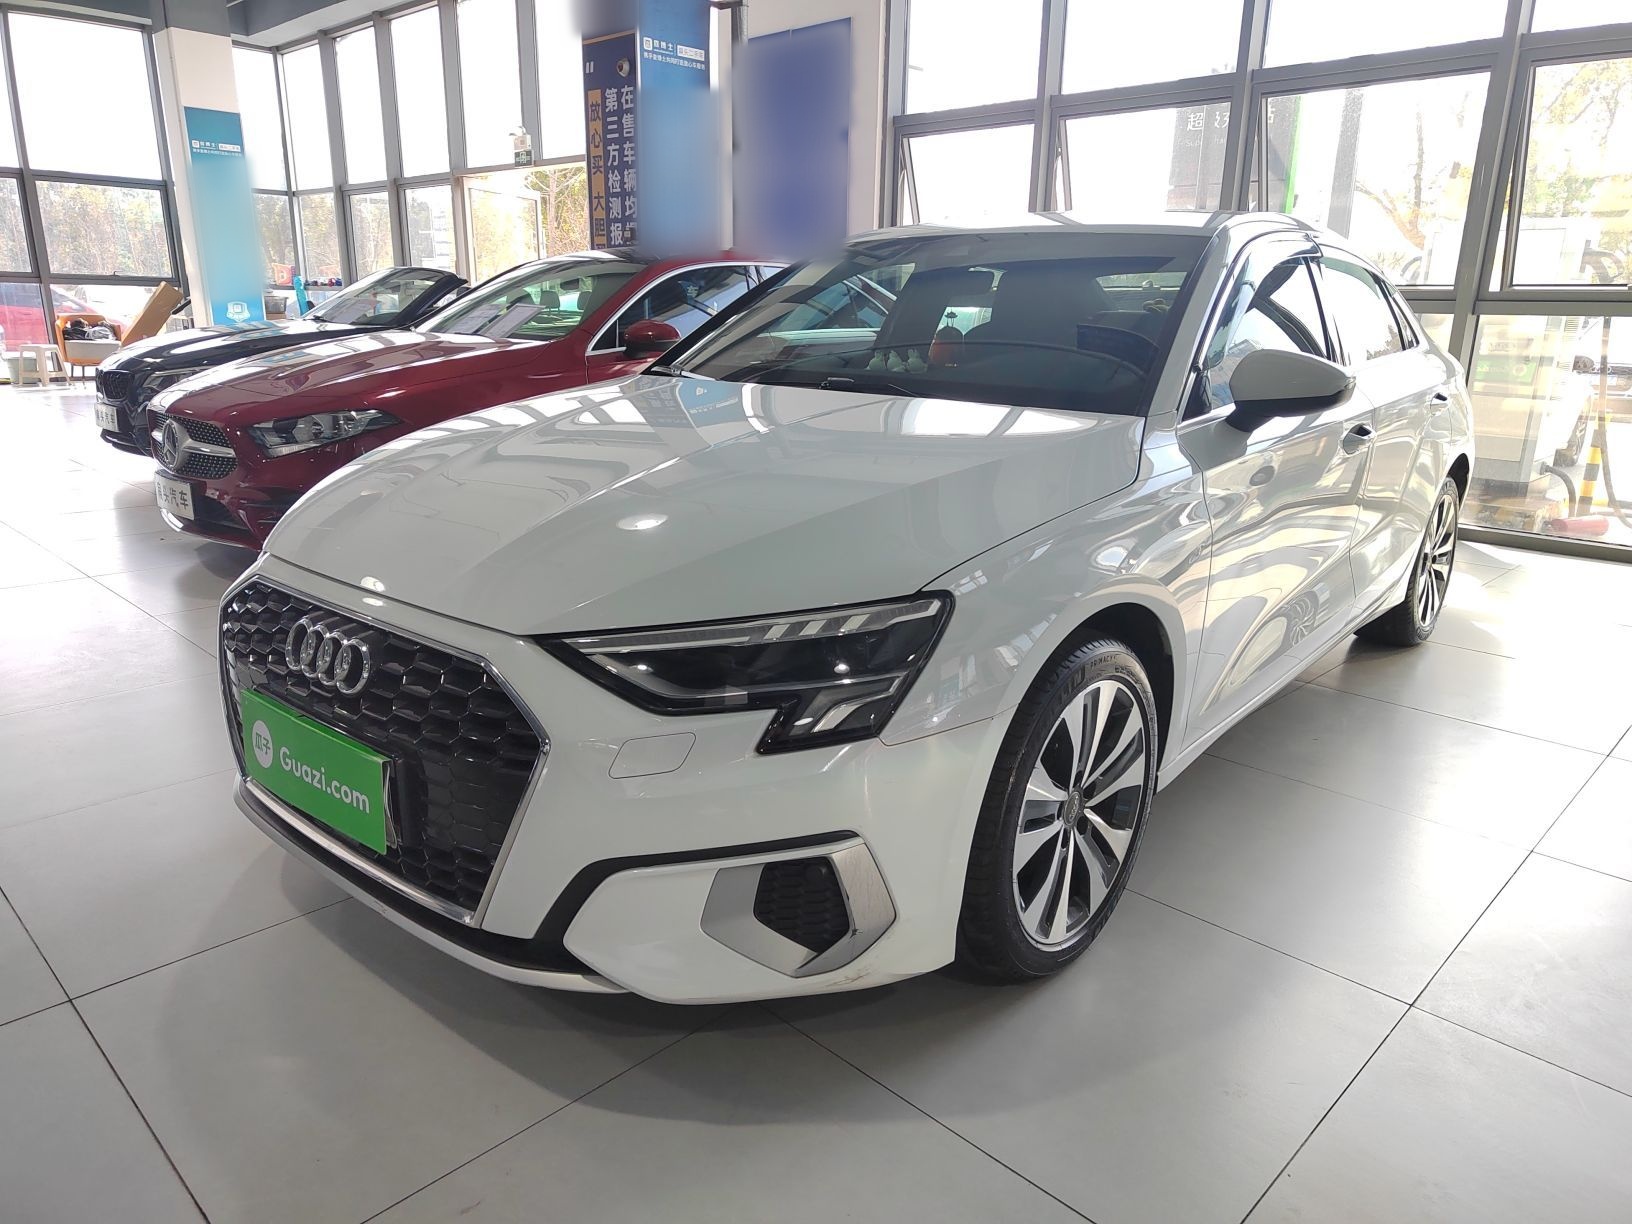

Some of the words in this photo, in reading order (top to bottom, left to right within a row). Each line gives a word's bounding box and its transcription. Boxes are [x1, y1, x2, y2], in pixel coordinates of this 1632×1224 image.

[605, 88, 623, 245] 第三方检测报
[593, 193, 606, 249] 大胆
[255, 732, 271, 755] 瓜子
[280, 746, 370, 814] Guazi.com
